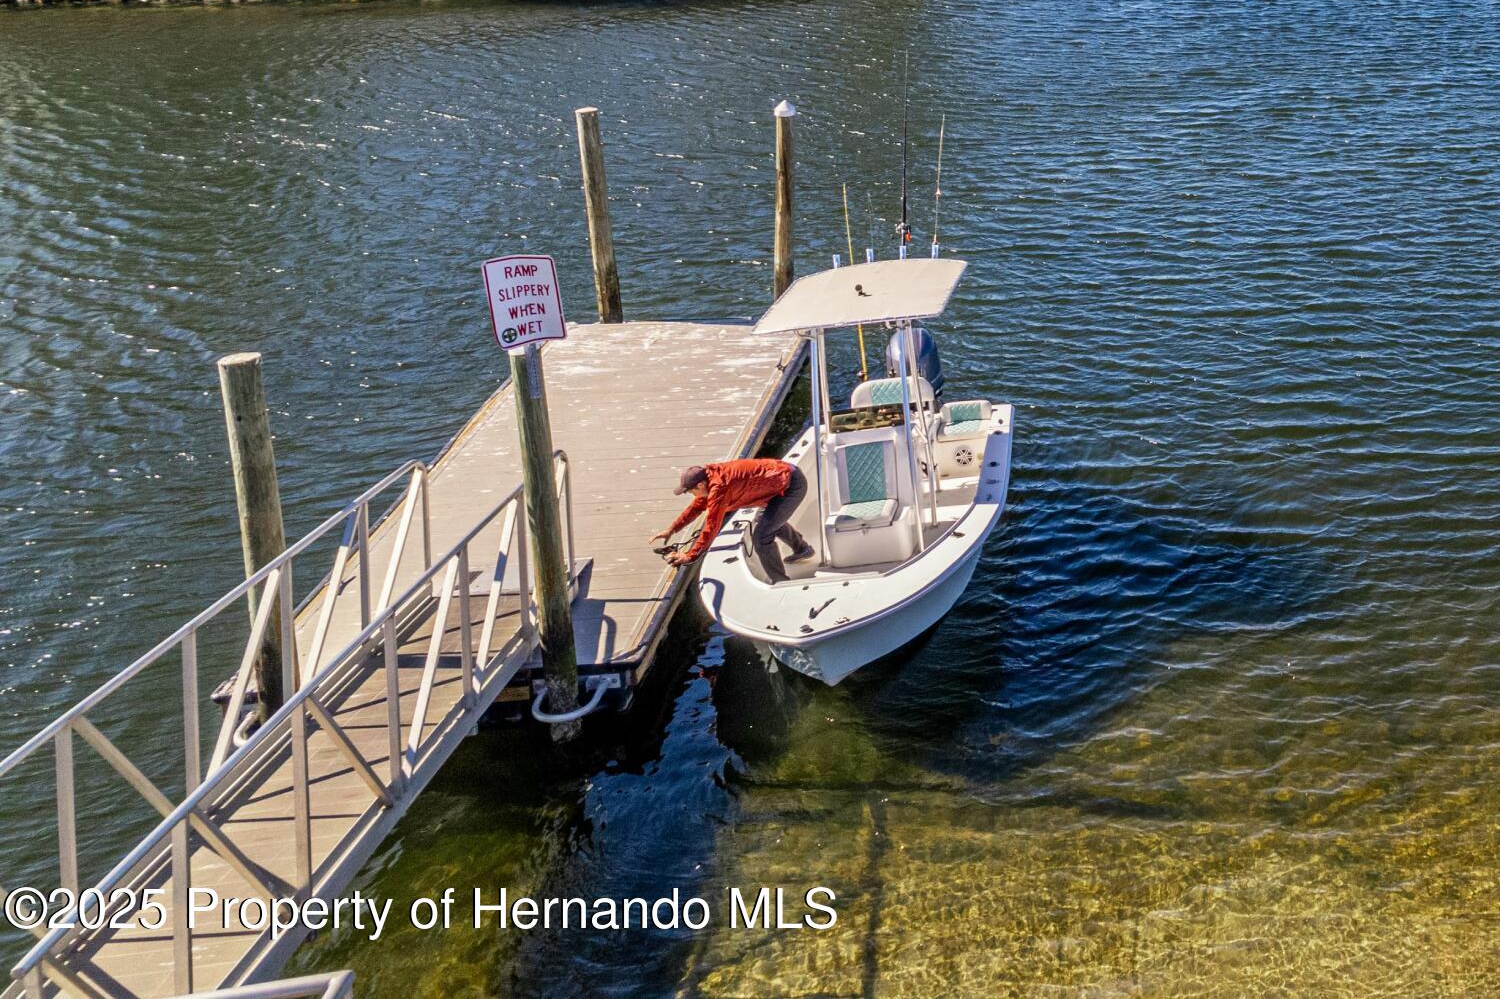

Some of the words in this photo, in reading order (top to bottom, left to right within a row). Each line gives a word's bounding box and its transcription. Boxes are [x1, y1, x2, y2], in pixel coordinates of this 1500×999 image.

[504, 264, 538, 279] RAMP
[498, 284, 550, 302] SLIPPERY
[508, 303, 546, 320] WHEN
[516, 320, 543, 336] WET
